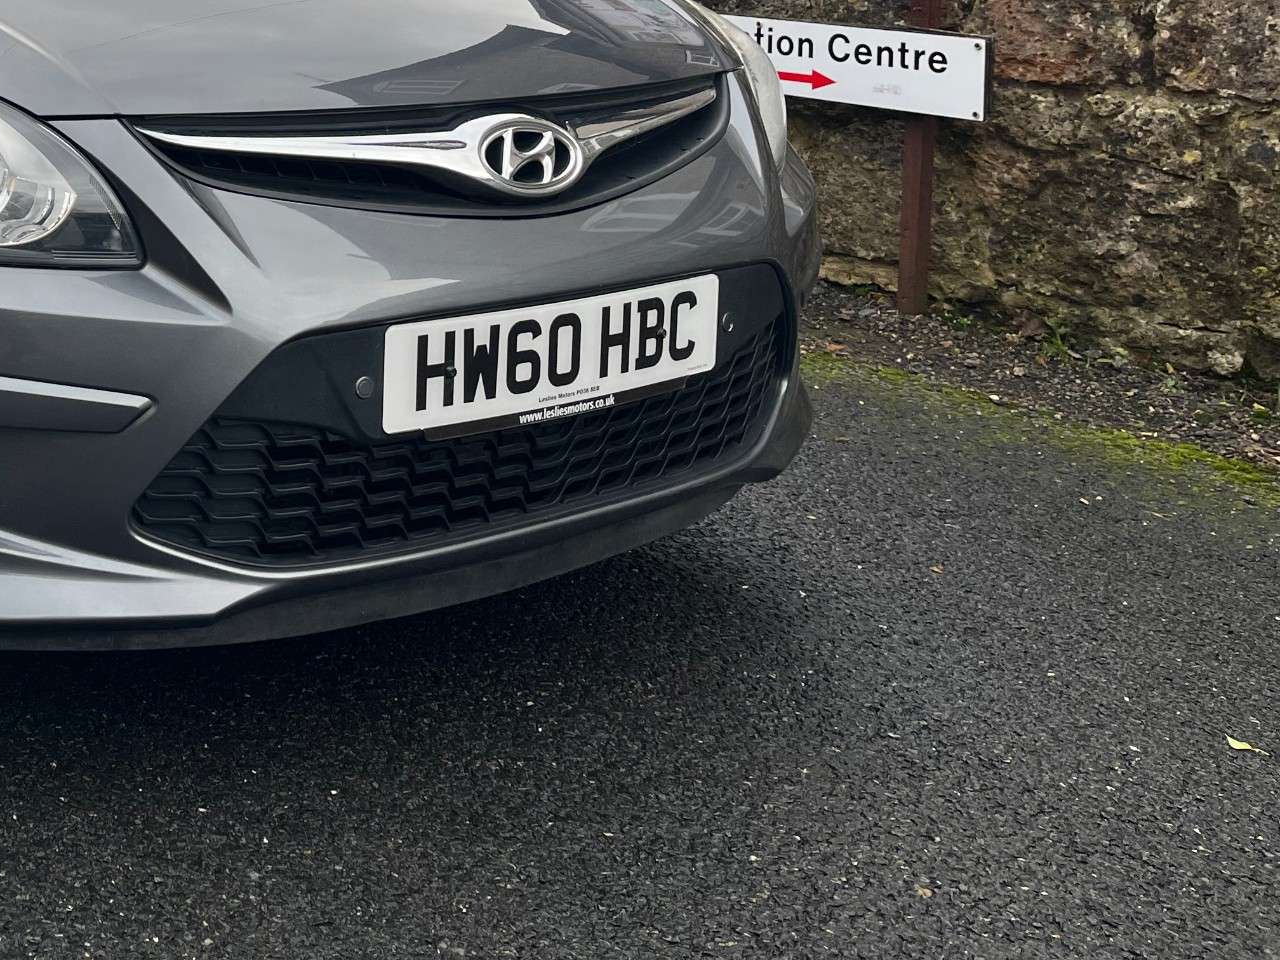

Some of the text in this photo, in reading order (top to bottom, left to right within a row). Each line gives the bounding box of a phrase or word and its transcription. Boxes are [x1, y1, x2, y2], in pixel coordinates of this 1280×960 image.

[828, 33, 948, 73] Centre
[415, 290, 698, 412] HW60 HBC
[519, 394, 615, 424] www.lesliesmotors.co.uk
